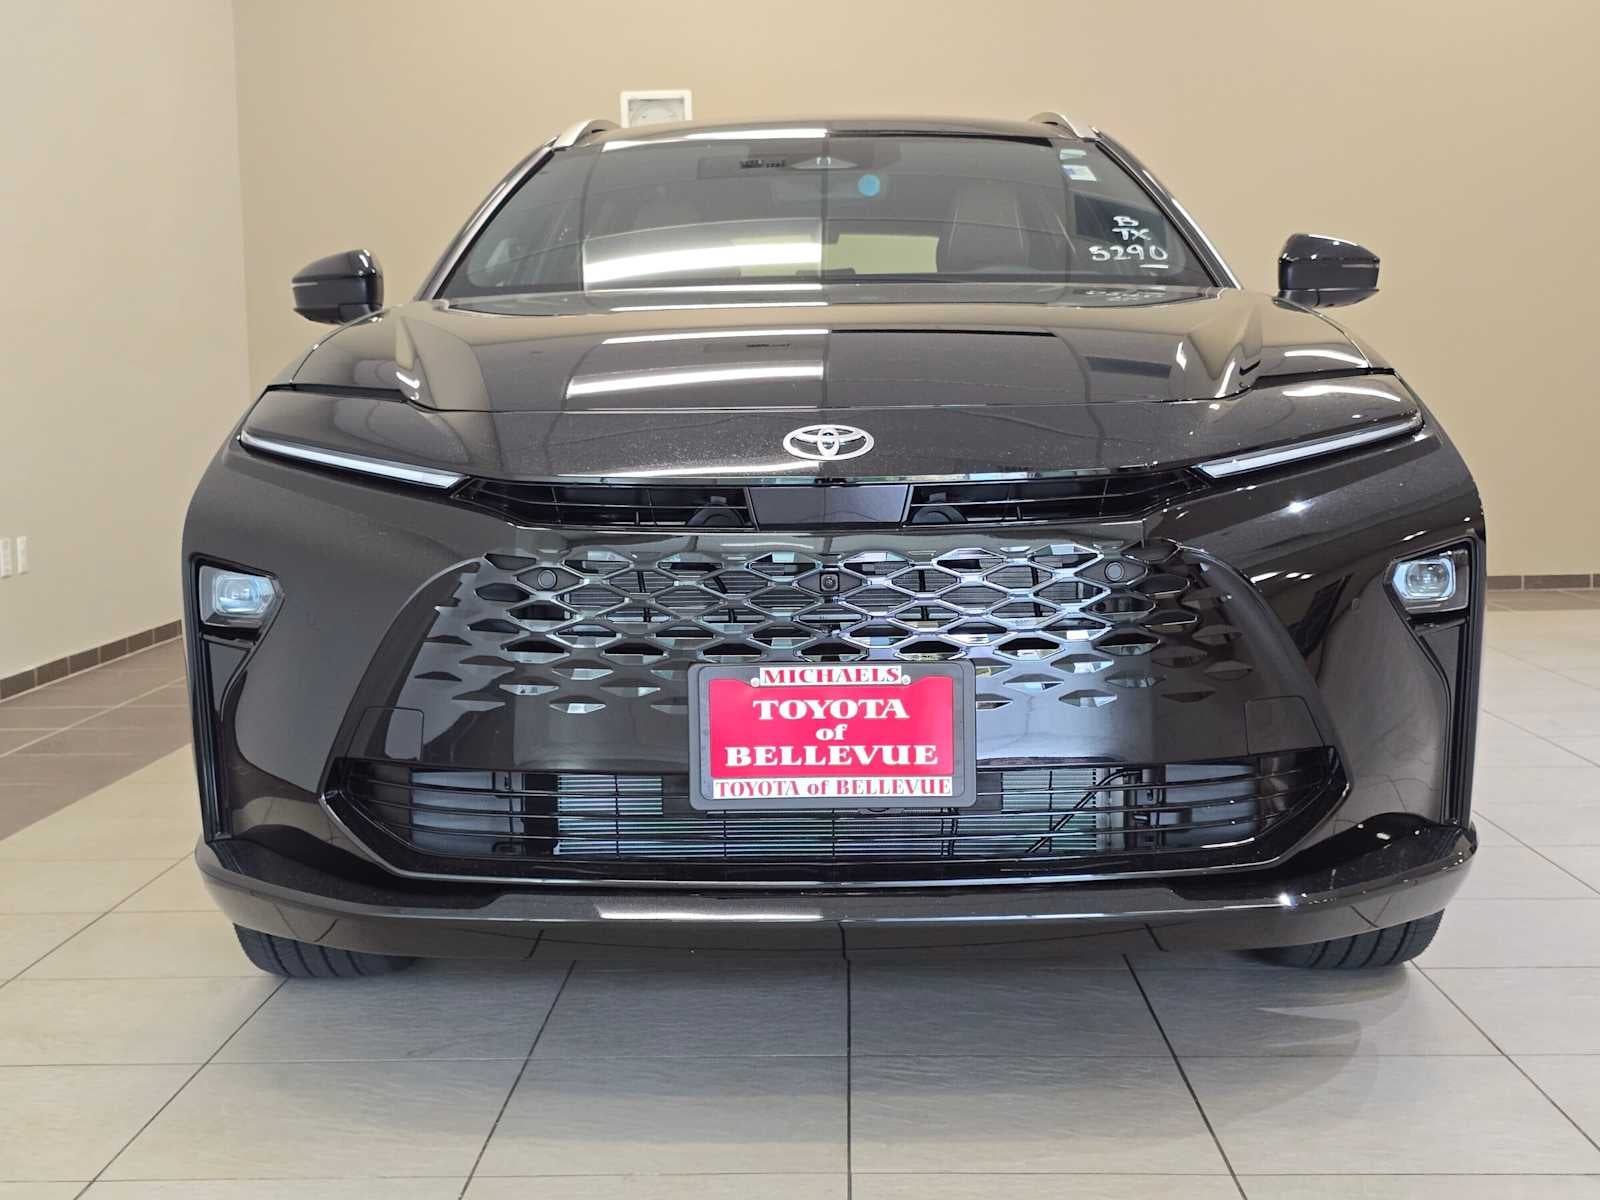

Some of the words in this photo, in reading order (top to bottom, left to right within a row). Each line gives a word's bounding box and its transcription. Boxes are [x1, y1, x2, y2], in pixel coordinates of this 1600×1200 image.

[1112, 228, 1152, 241] TX
[1088, 244, 1169, 261] 5290
[763, 667, 900, 684] MICHAELS
[753, 698, 910, 721] TOYOTA
[815, 723, 848, 741] of
[724, 745, 938, 767] BELLEVUE
[715, 780, 801, 797] TOYOTA
[807, 779, 829, 795] of
[836, 778, 951, 796] BELLEVUE
